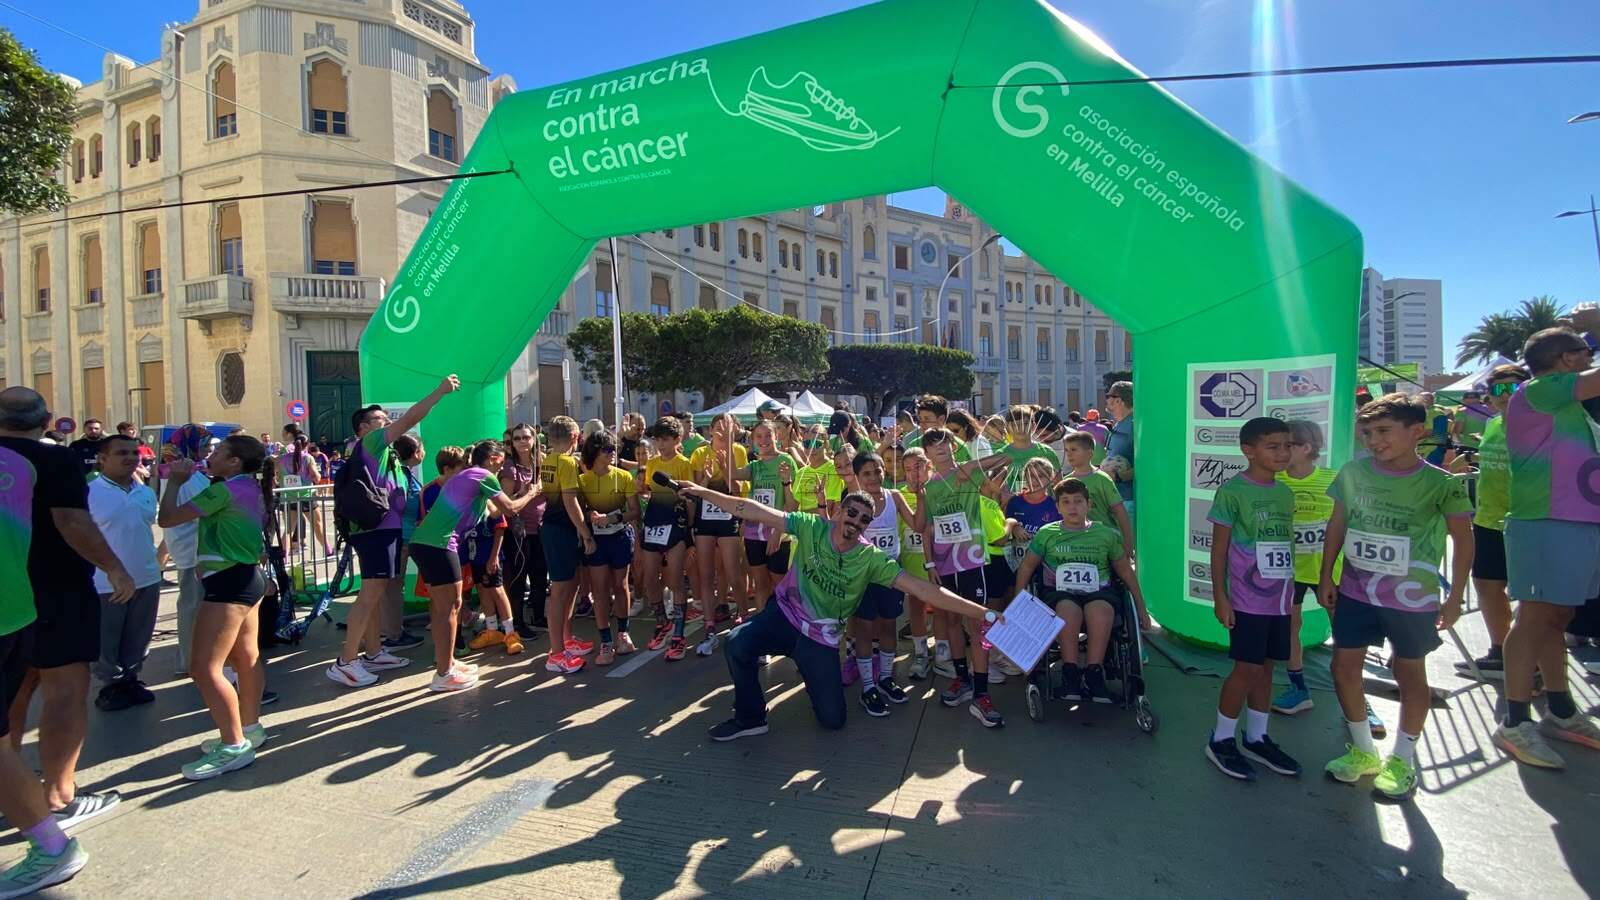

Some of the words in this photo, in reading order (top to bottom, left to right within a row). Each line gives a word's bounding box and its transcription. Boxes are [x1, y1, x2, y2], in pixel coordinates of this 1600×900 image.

[546, 87, 582, 109] En
[589, 58, 708, 99] marcha
[543, 103, 640, 141] contra
[549, 146, 579, 178] el
[582, 131, 688, 173] cáncer
[1046, 143, 1070, 165] en
[1068, 156, 1125, 208] Melilla
[1063, 123, 1118, 167] contra
[1116, 165, 1138, 181] el
[1134, 176, 1194, 224] cáncer
[1079, 104, 1166, 173] asociación
[1166, 169, 1245, 232] española
[423, 281, 436, 297] en
[430, 243, 461, 283] Melilla
[706, 503, 721, 513] 22
[939, 521, 962, 536] 138
[1350, 508, 1409, 531] Melilla
[647, 526, 666, 538] 215
[871, 535, 894, 548] 162
[909, 534, 922, 545] 13
[1294, 529, 1326, 545] 202
[1265, 551, 1291, 568] 139
[1353, 541, 1396, 562] 150
[1063, 570, 1092, 584] 214
